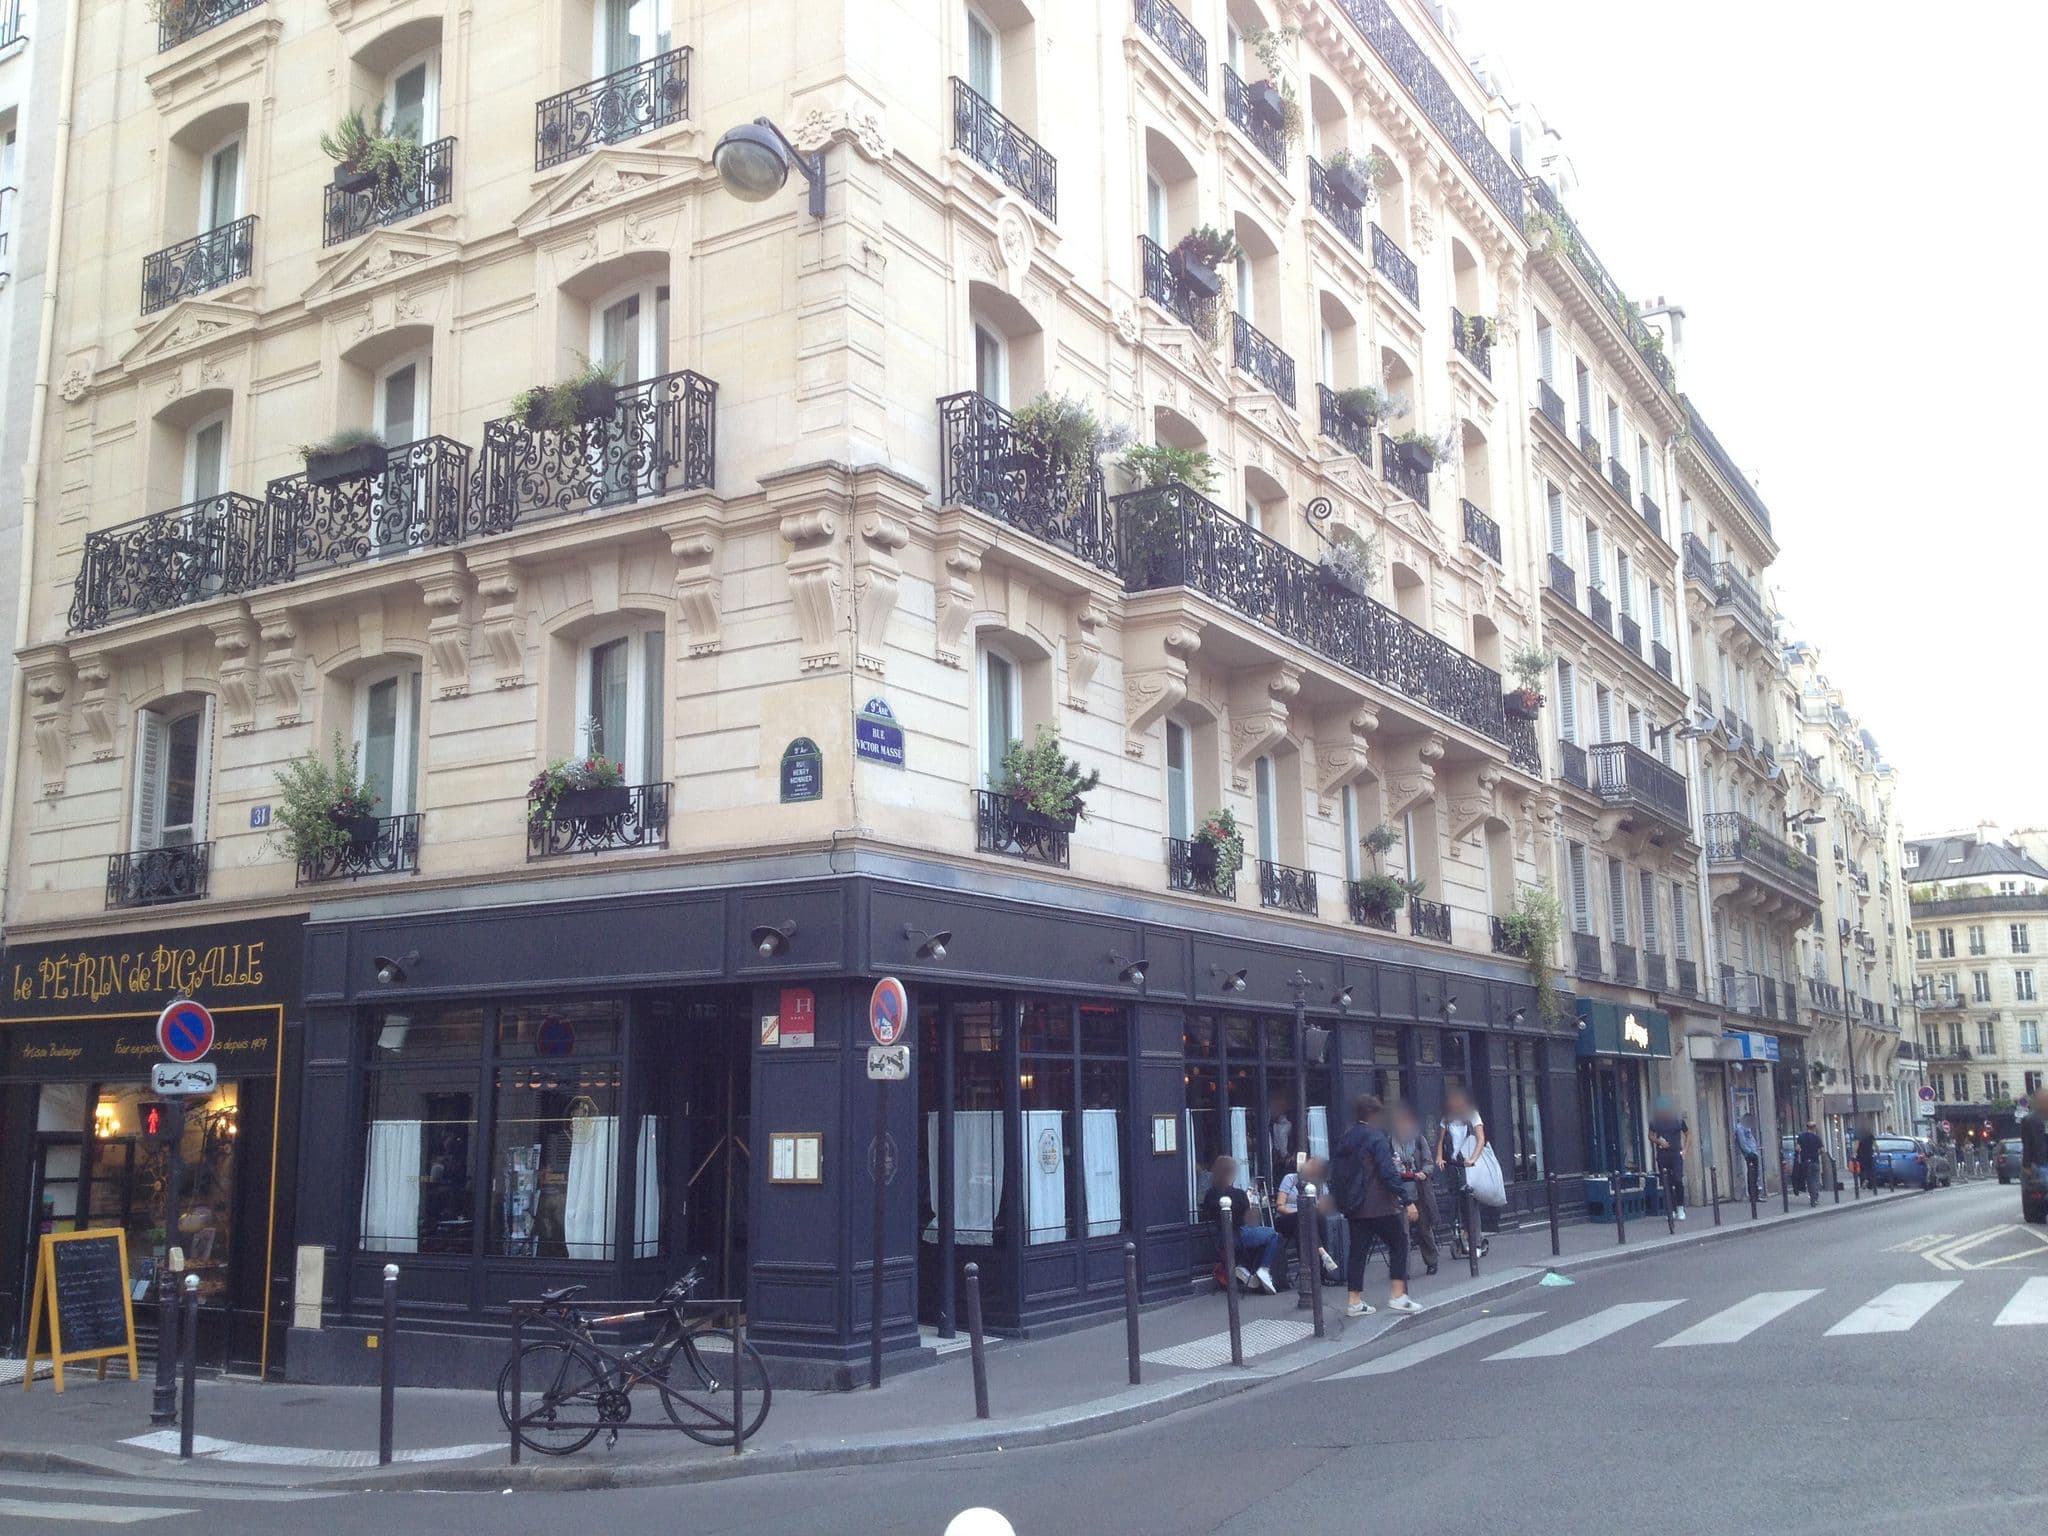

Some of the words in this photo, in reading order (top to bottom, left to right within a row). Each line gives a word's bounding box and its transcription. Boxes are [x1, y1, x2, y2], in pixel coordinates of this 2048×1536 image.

[872, 727, 886, 740] RUE
[856, 739, 880, 754] VICTOR
[880, 745, 903, 759] MASSÉ
[254, 808, 266, 825] 31
[38, 952, 130, 1003] PÉTRIN
[129, 951, 150, 992] de
[151, 941, 264, 998] PIGALLE
[796, 998, 814, 1014] H
